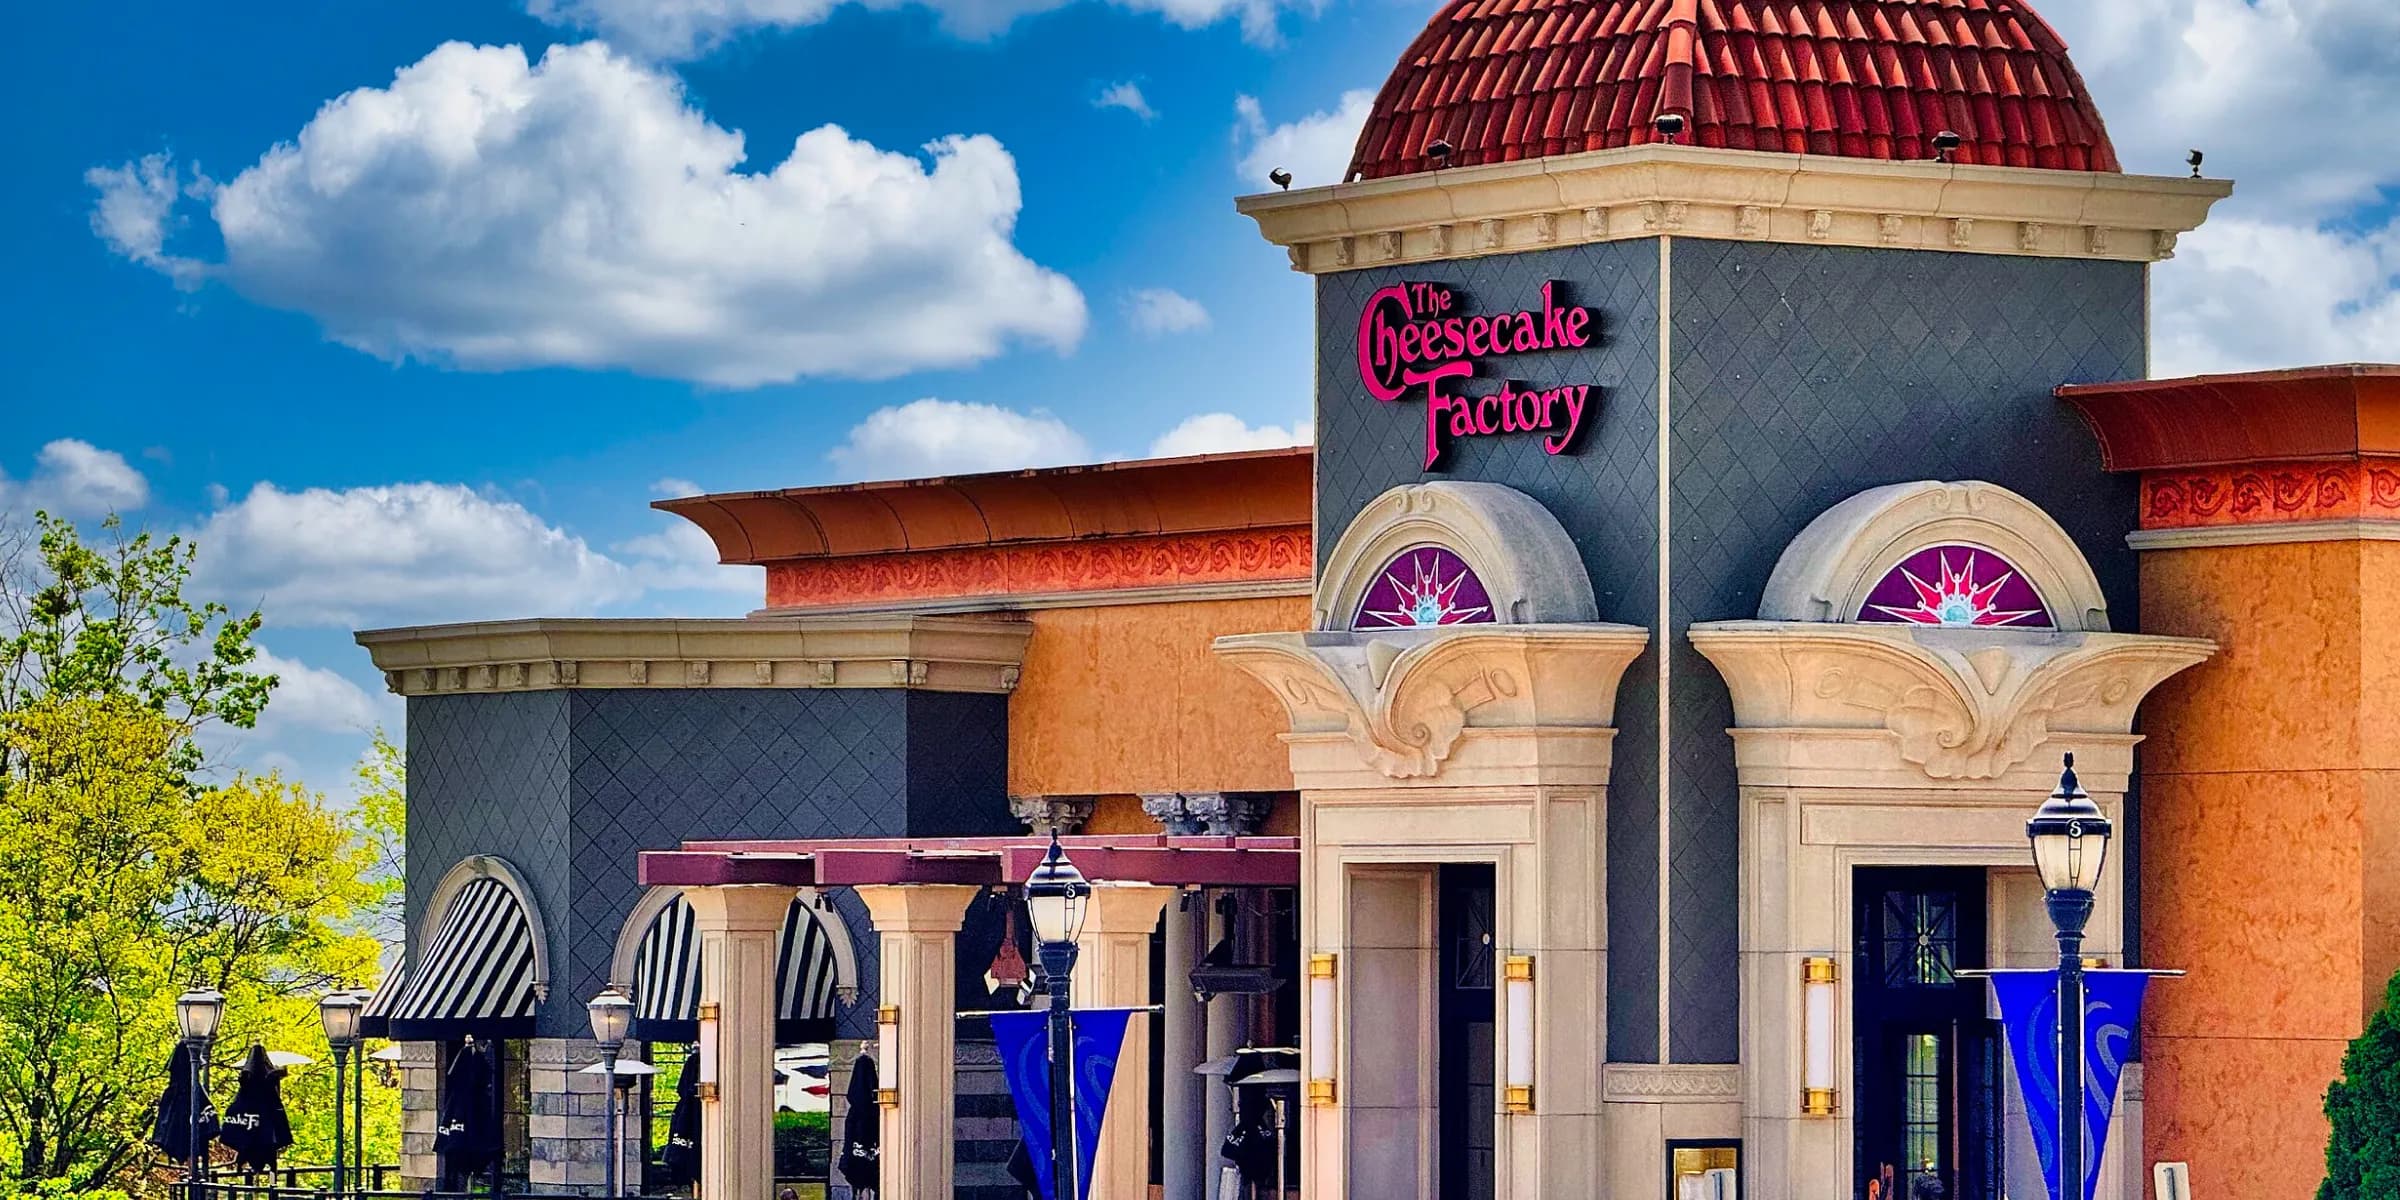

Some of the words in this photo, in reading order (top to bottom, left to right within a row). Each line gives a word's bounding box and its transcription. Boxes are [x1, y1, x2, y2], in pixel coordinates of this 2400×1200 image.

[1411, 283, 1451, 318] The
[1357, 280, 1590, 401] Cheesecake
[1403, 361, 1589, 472] Factory
[2070, 821, 2082, 837] S
[1066, 884, 1076, 898] S
